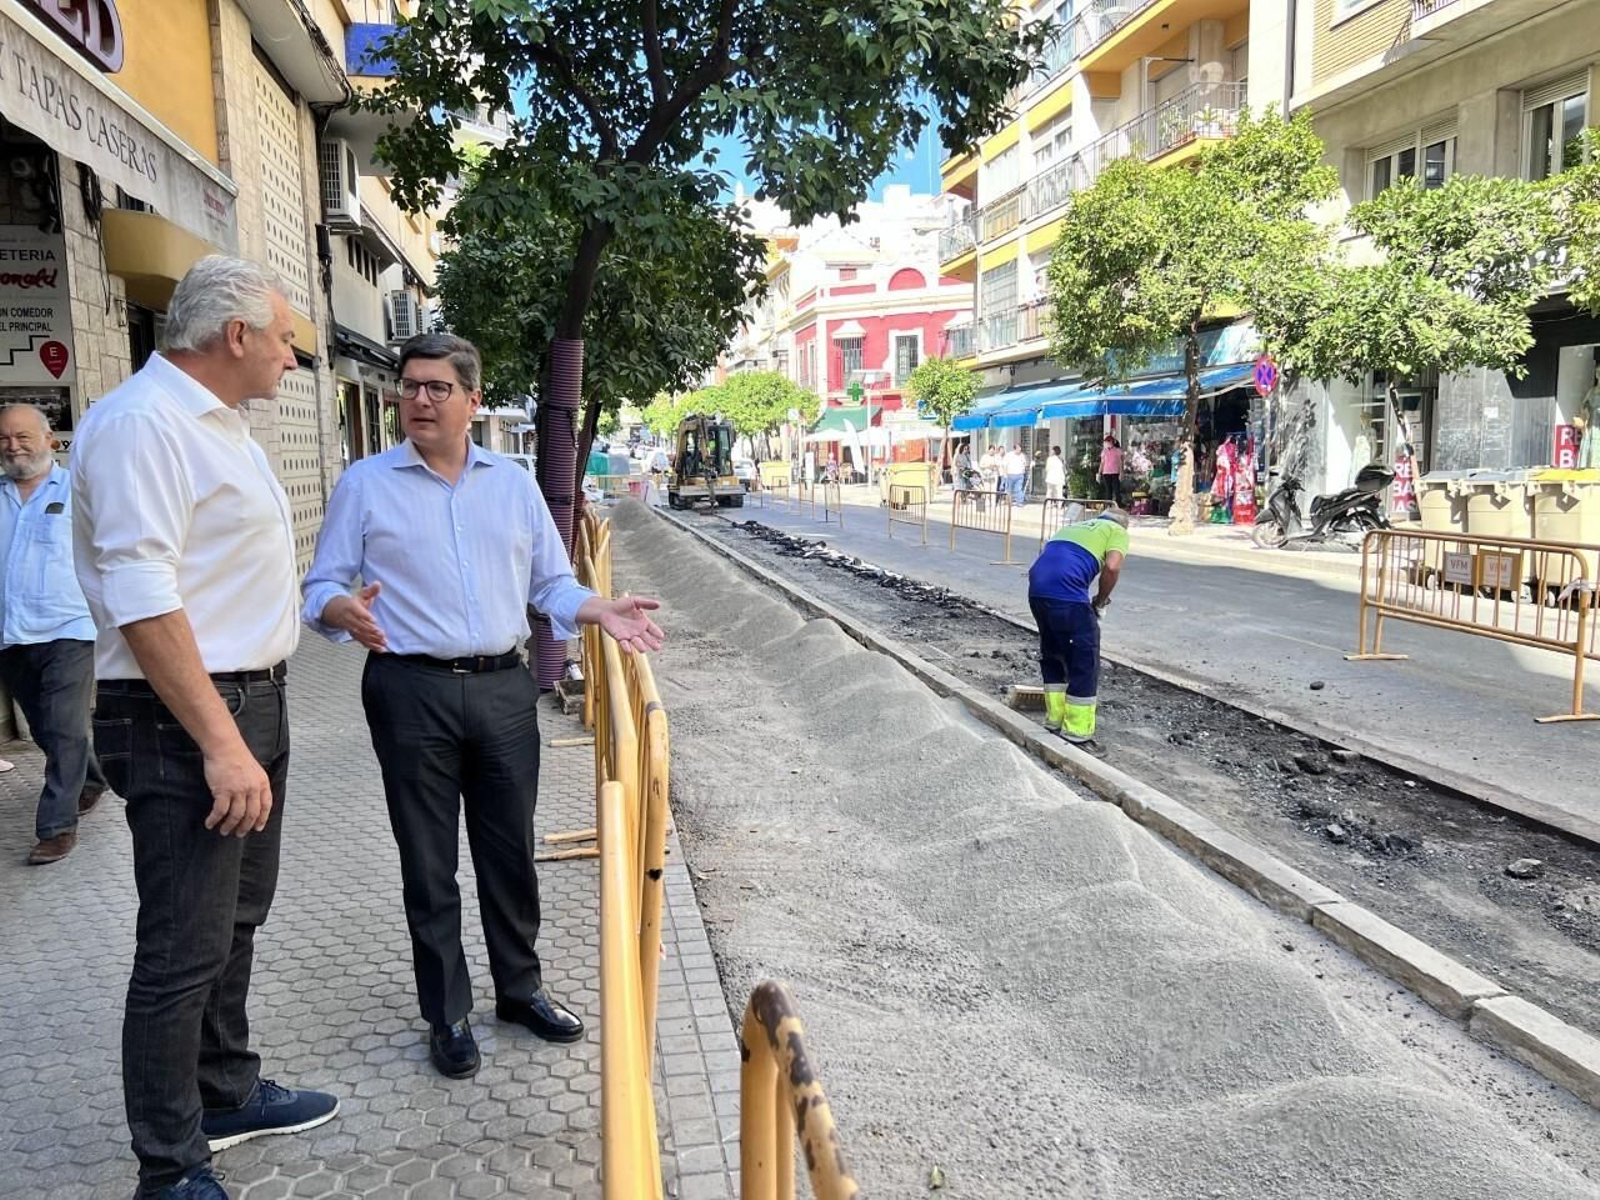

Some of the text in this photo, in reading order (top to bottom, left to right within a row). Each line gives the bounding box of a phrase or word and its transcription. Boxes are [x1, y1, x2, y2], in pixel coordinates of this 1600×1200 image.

[12, 50, 82, 130] TAPAS
[86, 106, 157, 183] CASERAS
[10, 307, 54, 319] COMEDOR
[9, 321, 54, 332] PRINCIPAL
[49, 346, 59, 357] E
[1450, 559, 1468, 571] VFM
